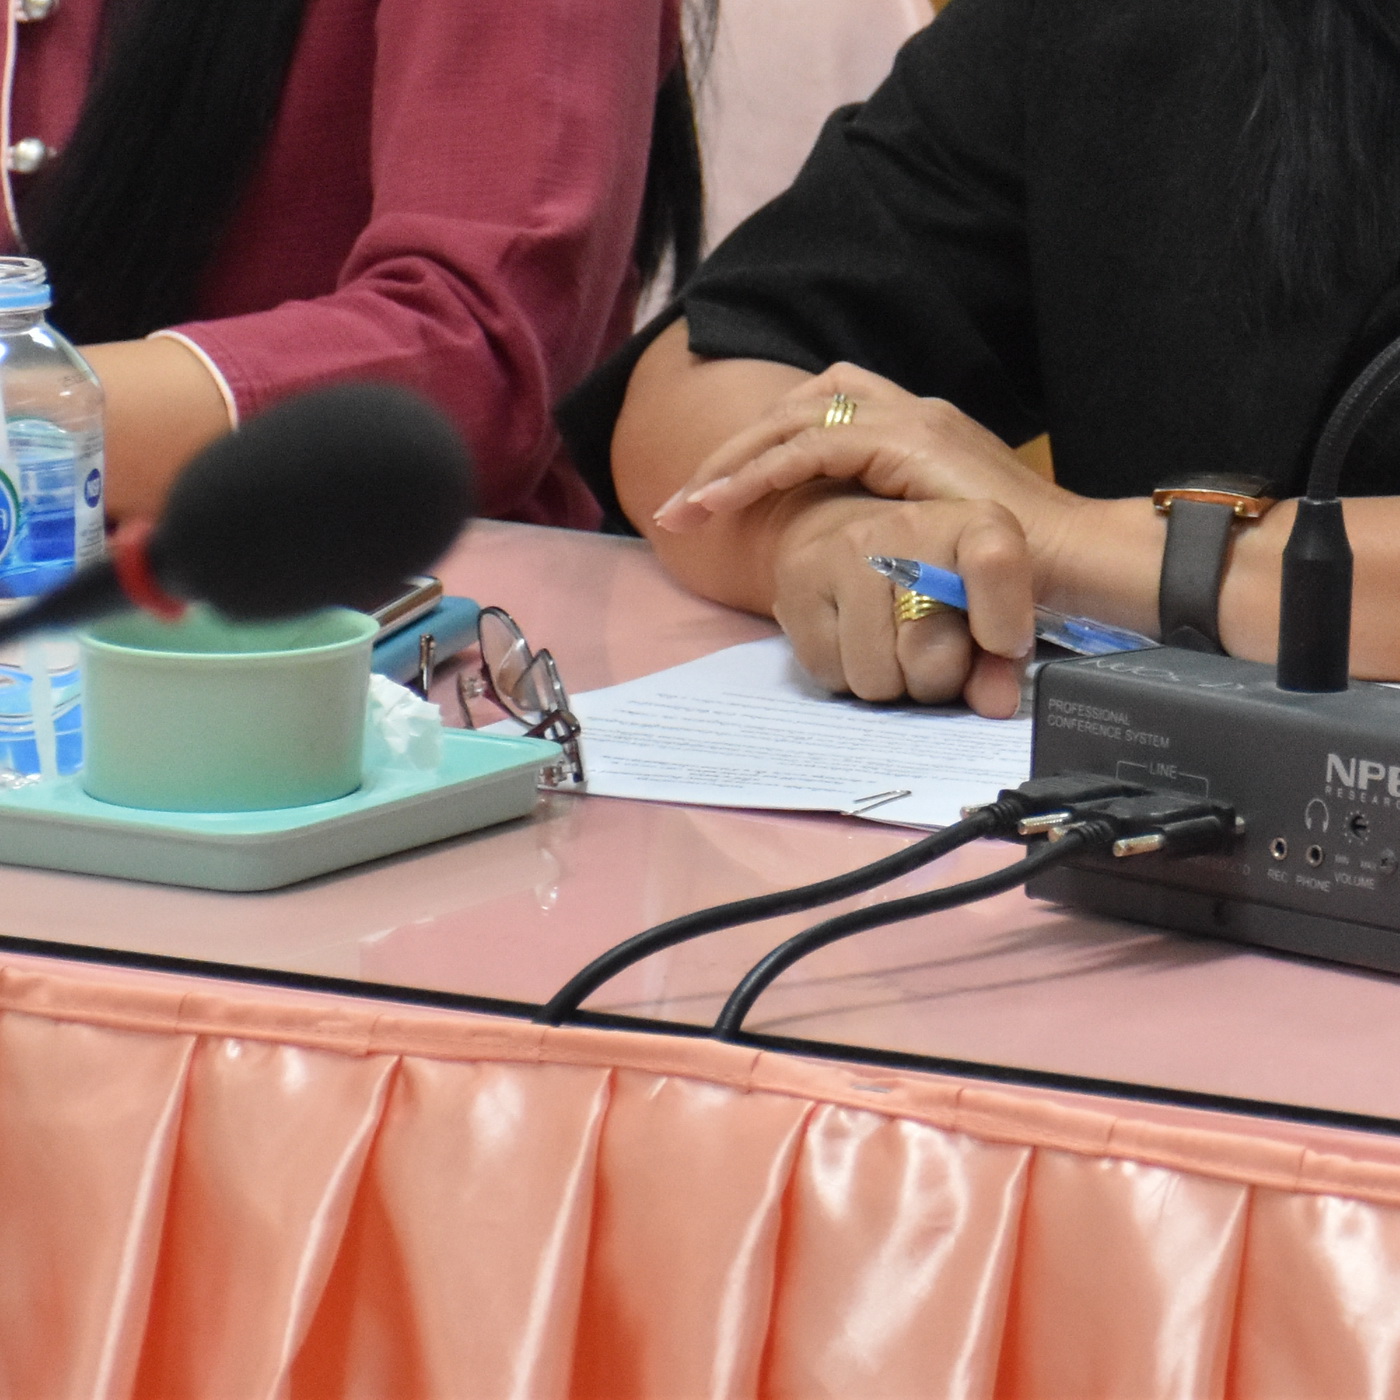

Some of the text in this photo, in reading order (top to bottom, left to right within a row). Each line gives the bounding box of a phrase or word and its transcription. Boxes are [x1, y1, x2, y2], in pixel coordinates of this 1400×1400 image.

[1047, 698, 1131, 727] PROFESSIONAL
[1047, 713, 1171, 750] CONFERENCE SYSTEM
[1149, 764, 1178, 781] LINE
[1267, 868, 1377, 894] REC PHONE VOLUME
